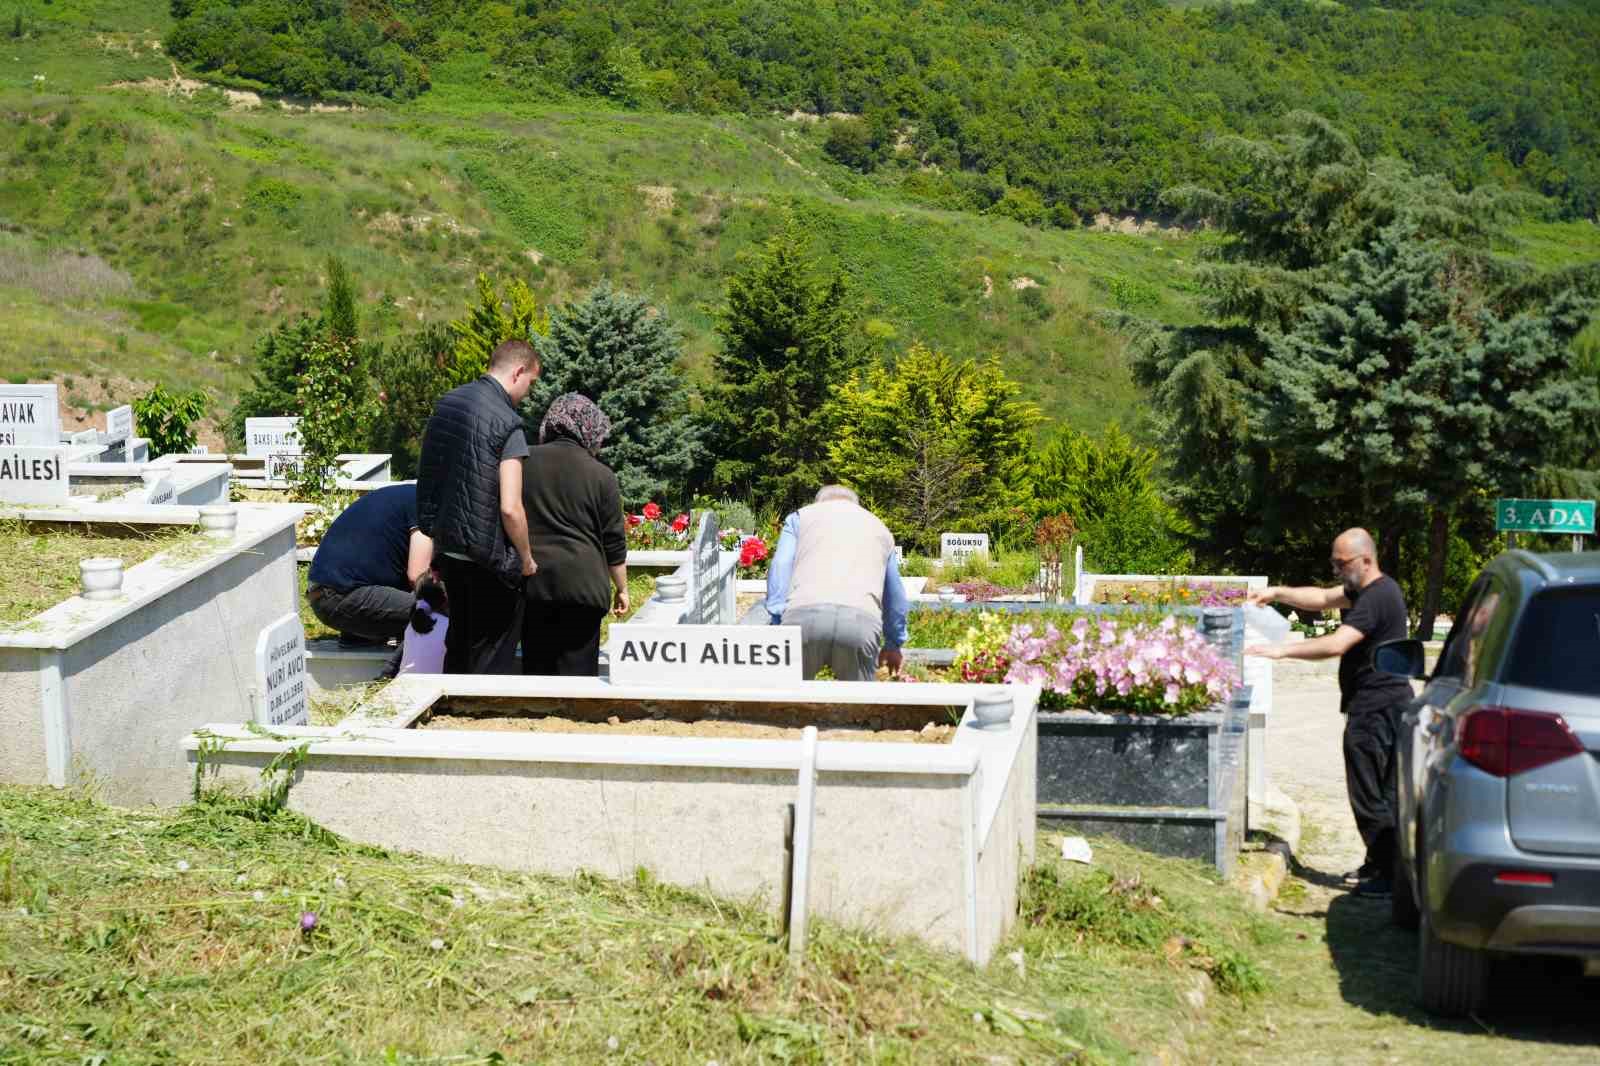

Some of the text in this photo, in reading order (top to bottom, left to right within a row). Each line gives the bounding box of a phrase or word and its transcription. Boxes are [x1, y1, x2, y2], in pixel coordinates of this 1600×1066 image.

[0, 453, 60, 480] AİLESİ
[1504, 507, 1586, 527] 3. ADA
[620, 638, 791, 666] AVCI AİLESİ
